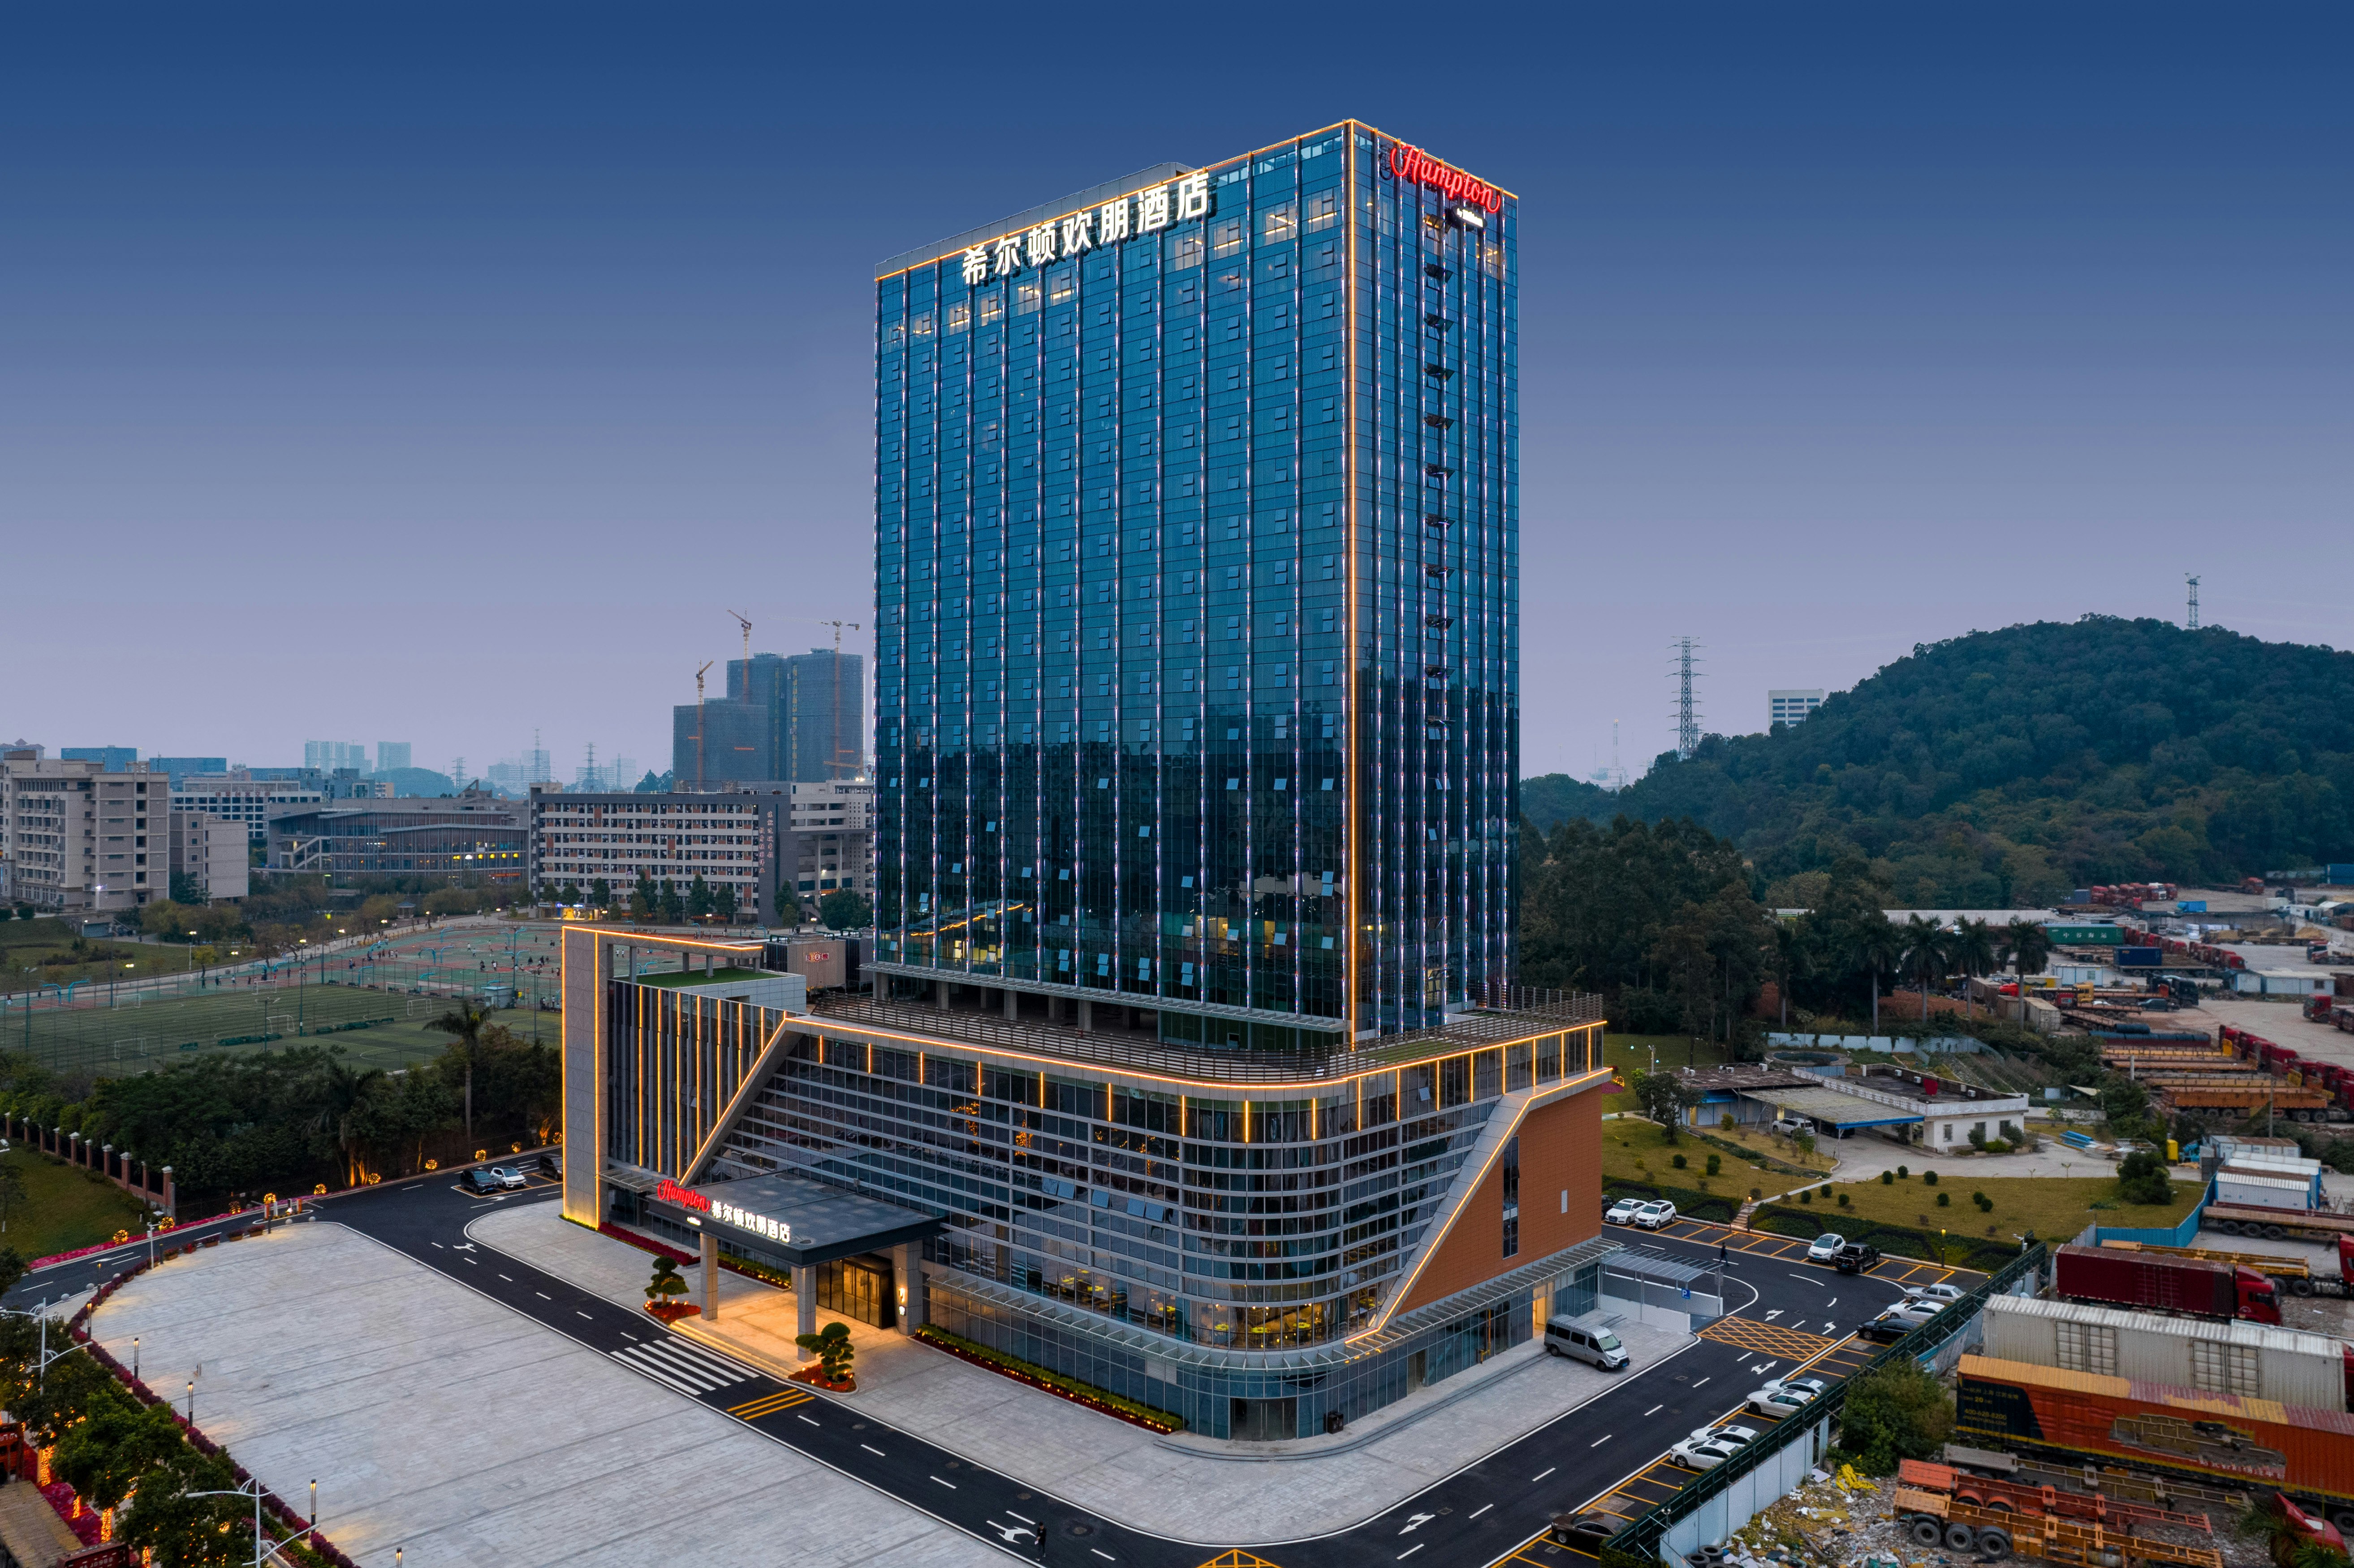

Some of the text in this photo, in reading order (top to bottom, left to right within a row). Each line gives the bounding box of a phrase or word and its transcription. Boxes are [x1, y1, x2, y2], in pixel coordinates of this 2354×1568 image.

[1390, 144, 1500, 214] Hampton
[962, 172, 1209, 285] 希尔顿欢朋酒店
[657, 1179, 711, 1212] Hampton
[712, 1200, 791, 1243] 希尔顿欢朋酒店
